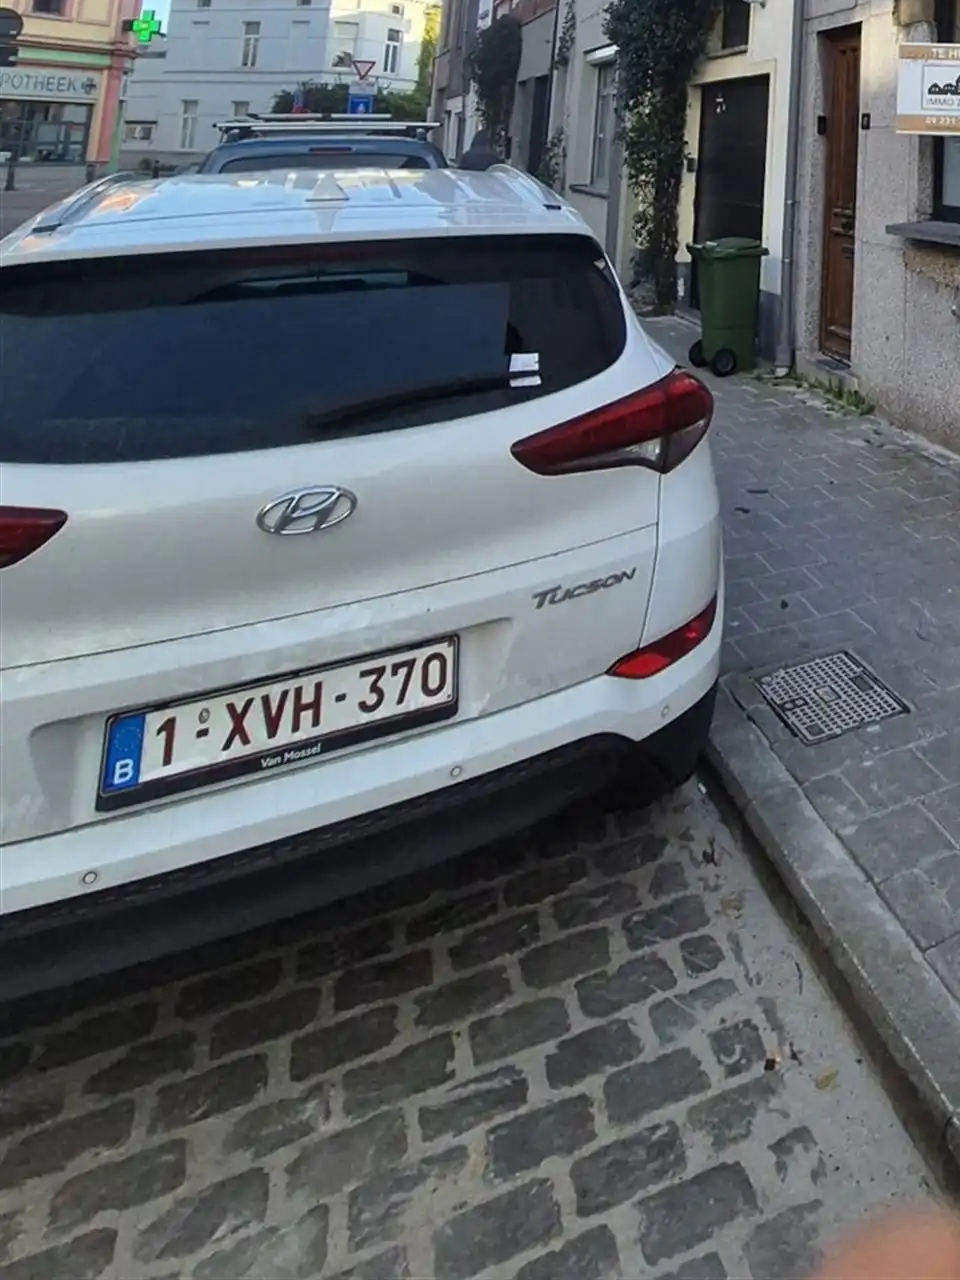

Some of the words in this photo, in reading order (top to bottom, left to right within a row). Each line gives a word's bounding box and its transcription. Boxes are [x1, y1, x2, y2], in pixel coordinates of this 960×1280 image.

[931, 48, 944, 58] TE
[0, 71, 77, 93] POTHEEK
[926, 97, 954, 106] IMMO
[531, 567, 637, 610] TUCSON
[156, 651, 448, 767] 1-XVH-370
[260, 755, 282, 768] Van
[284, 742, 322, 764] Mossel
[113, 758, 134, 785] B
